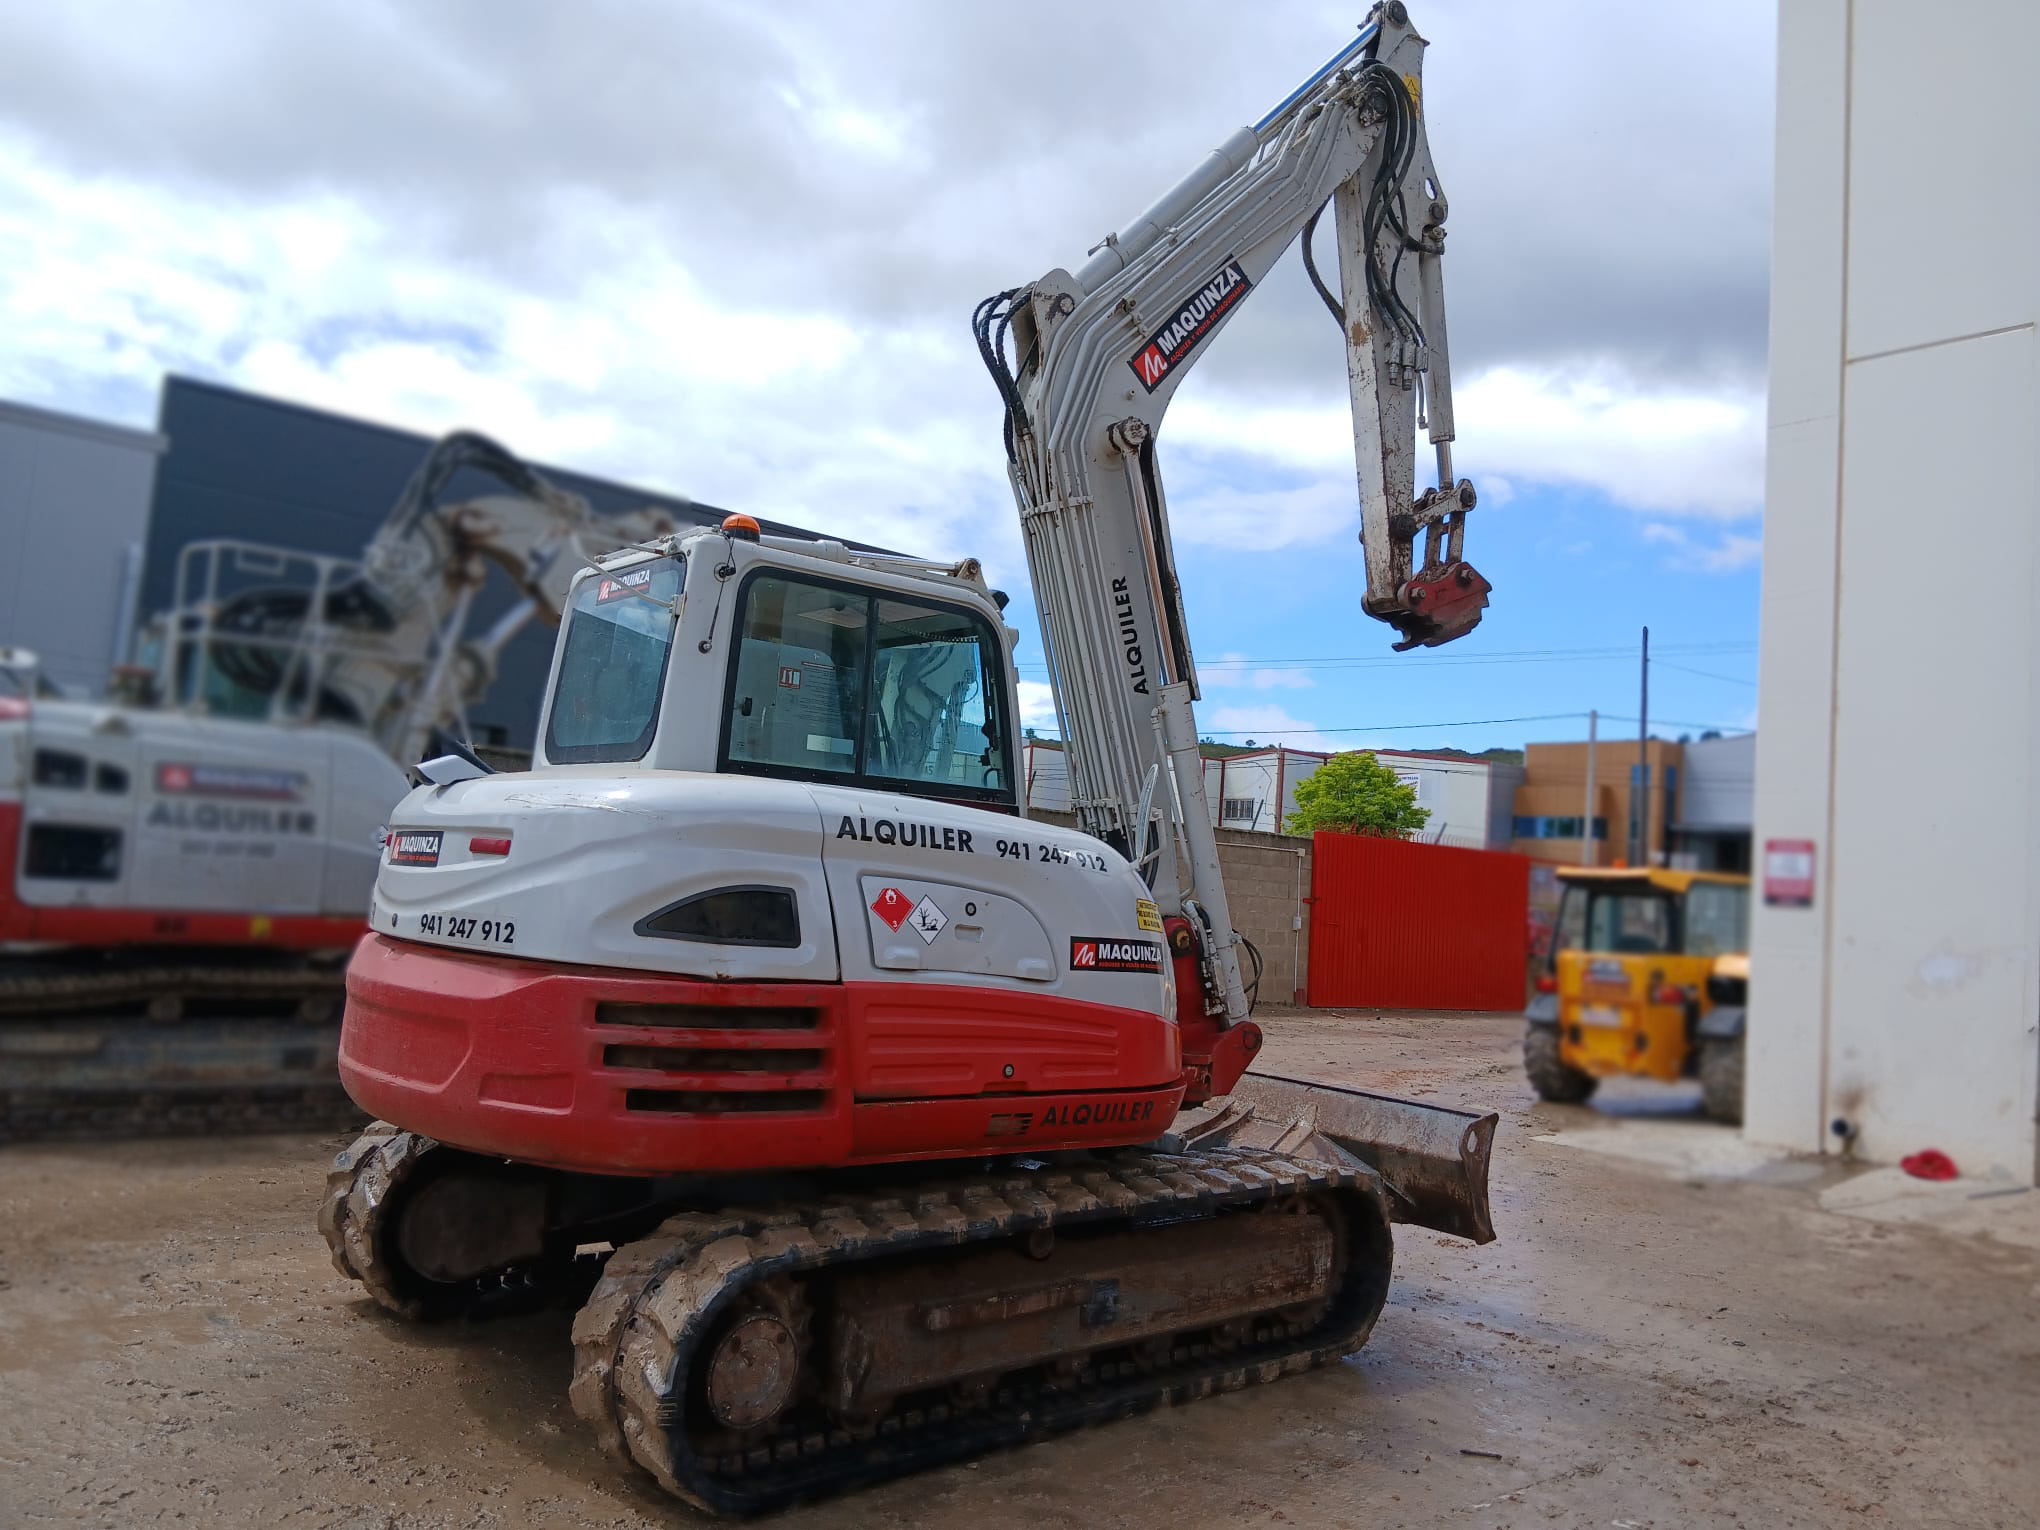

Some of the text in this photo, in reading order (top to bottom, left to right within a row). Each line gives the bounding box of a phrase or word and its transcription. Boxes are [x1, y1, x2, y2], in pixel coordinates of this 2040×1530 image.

[1157, 266, 1241, 356] MAQUINZA
[1112, 575, 1149, 695] ALQUILER
[147, 802, 316, 837] ALQUILER
[836, 815, 974, 853] ALQUILER
[399, 836, 439, 854] MAQUINZA
[996, 840, 1108, 872] 941 247 912
[421, 914, 515, 943] 941 247 912
[892, 920, 898, 928] 3
[1099, 944, 1162, 962] MAQUINZA
[1040, 1101, 1155, 1127] ALQUILER
